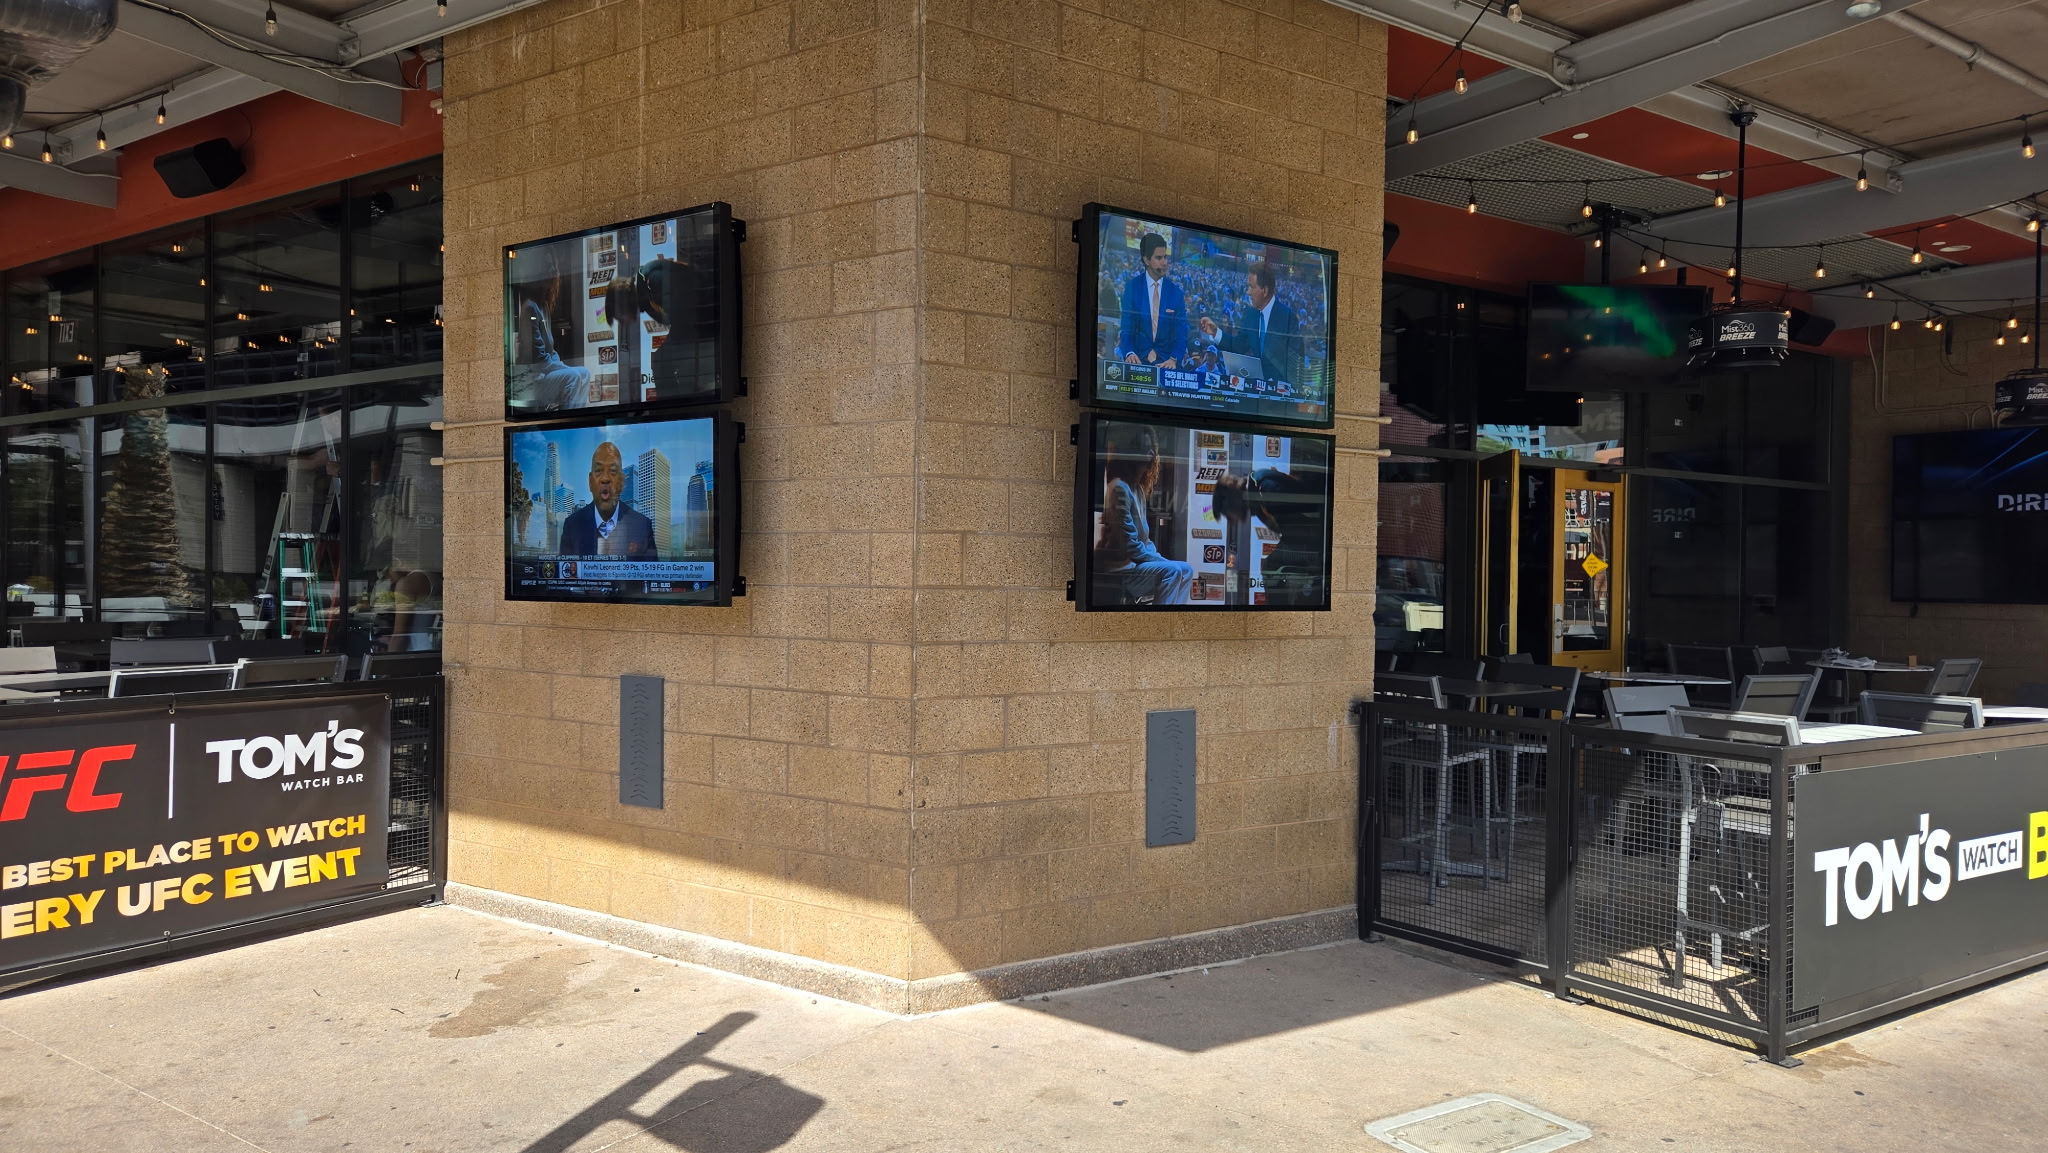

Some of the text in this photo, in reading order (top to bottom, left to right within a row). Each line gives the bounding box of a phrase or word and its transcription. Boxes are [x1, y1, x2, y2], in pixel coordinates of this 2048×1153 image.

[1721, 322, 1754, 334] Mist360
[1720, 332, 1756, 342] BREEZE
[601, 348, 614, 360] STP
[1196, 468, 1225, 480] REED
[1207, 548, 1221, 559] STP
[206, 720, 364, 784] TOM'S
[281, 773, 364, 792] WATCH BAR
[3, 814, 366, 890] BEST PLACE TO WATCH
[1814, 813, 1951, 926] TOM'S
[1962, 839, 2018, 872] WATCH
[117, 873, 214, 917] UFC
[224, 847, 361, 899] EVENT
